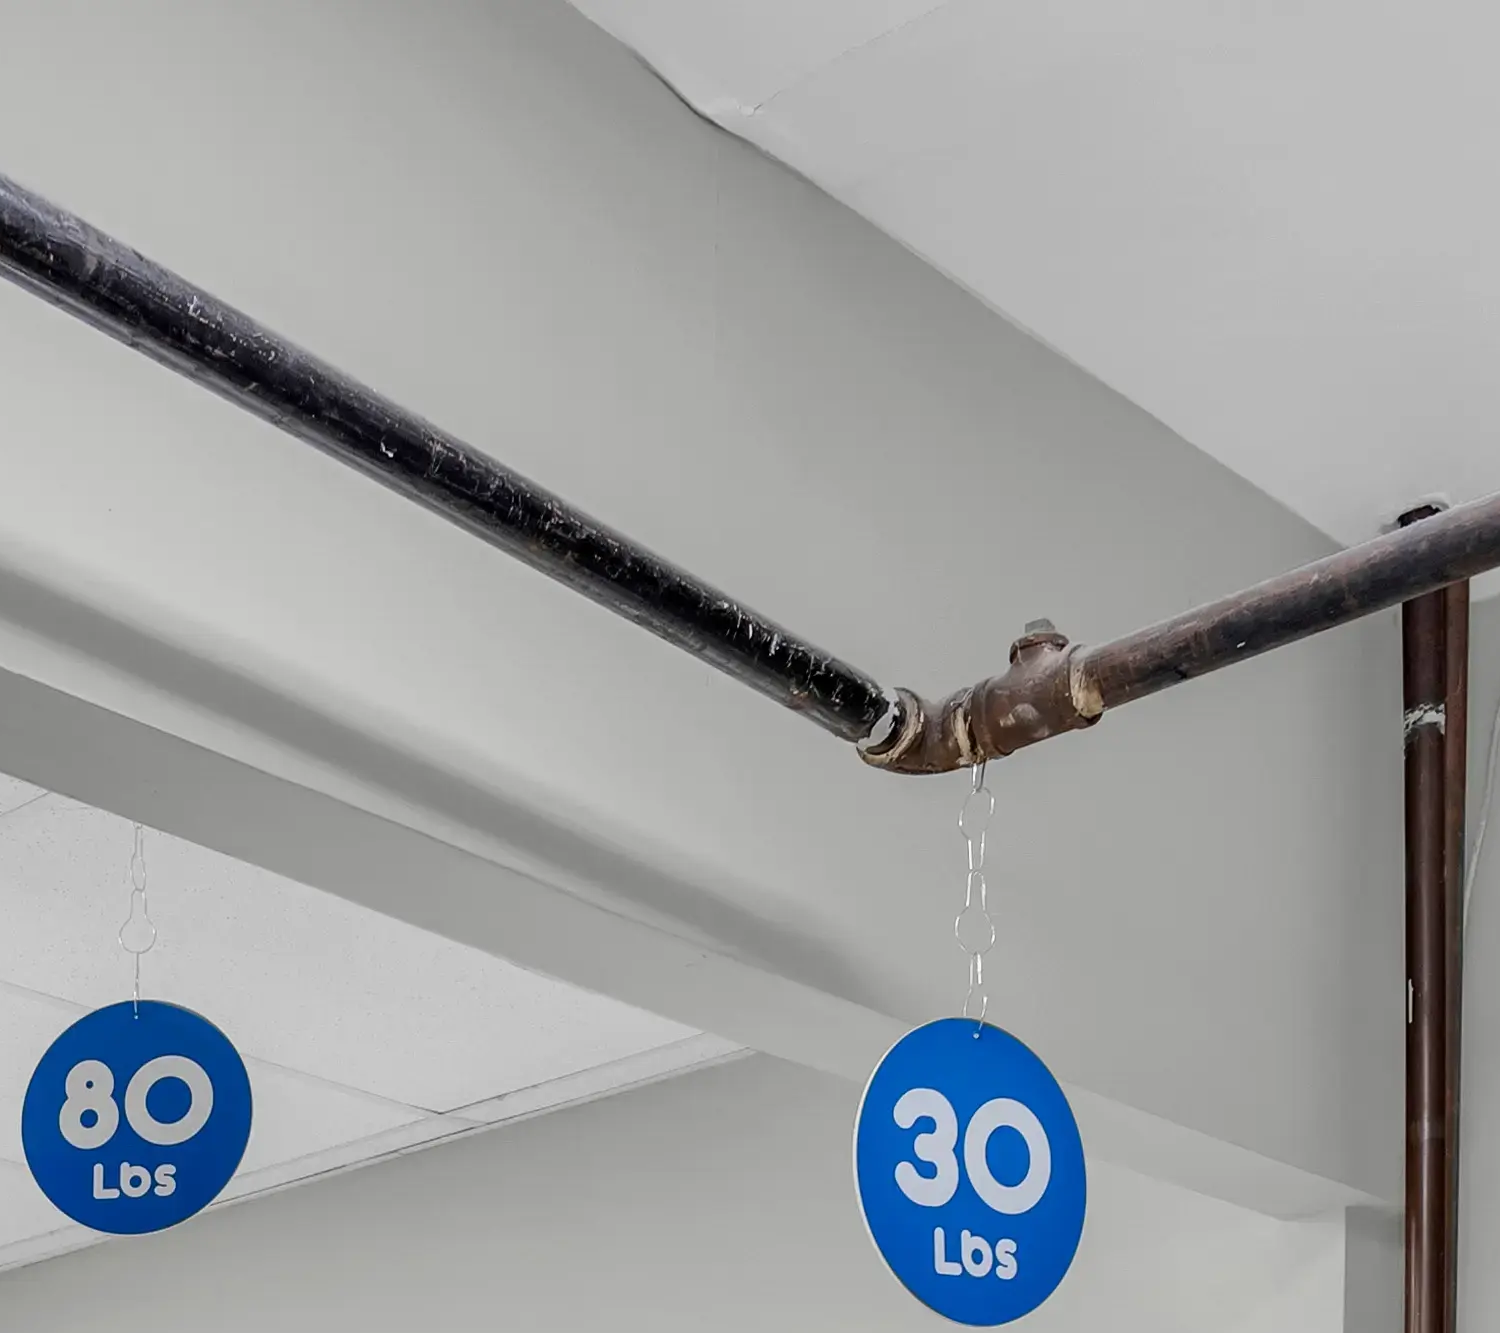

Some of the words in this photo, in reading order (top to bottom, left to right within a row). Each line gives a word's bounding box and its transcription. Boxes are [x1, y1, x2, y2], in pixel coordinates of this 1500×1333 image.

[58, 1055, 214, 1149] 80
[92, 1161, 177, 1200] Lbs
[893, 1087, 1051, 1216] 30
[933, 1227, 1018, 1280] Lbs
